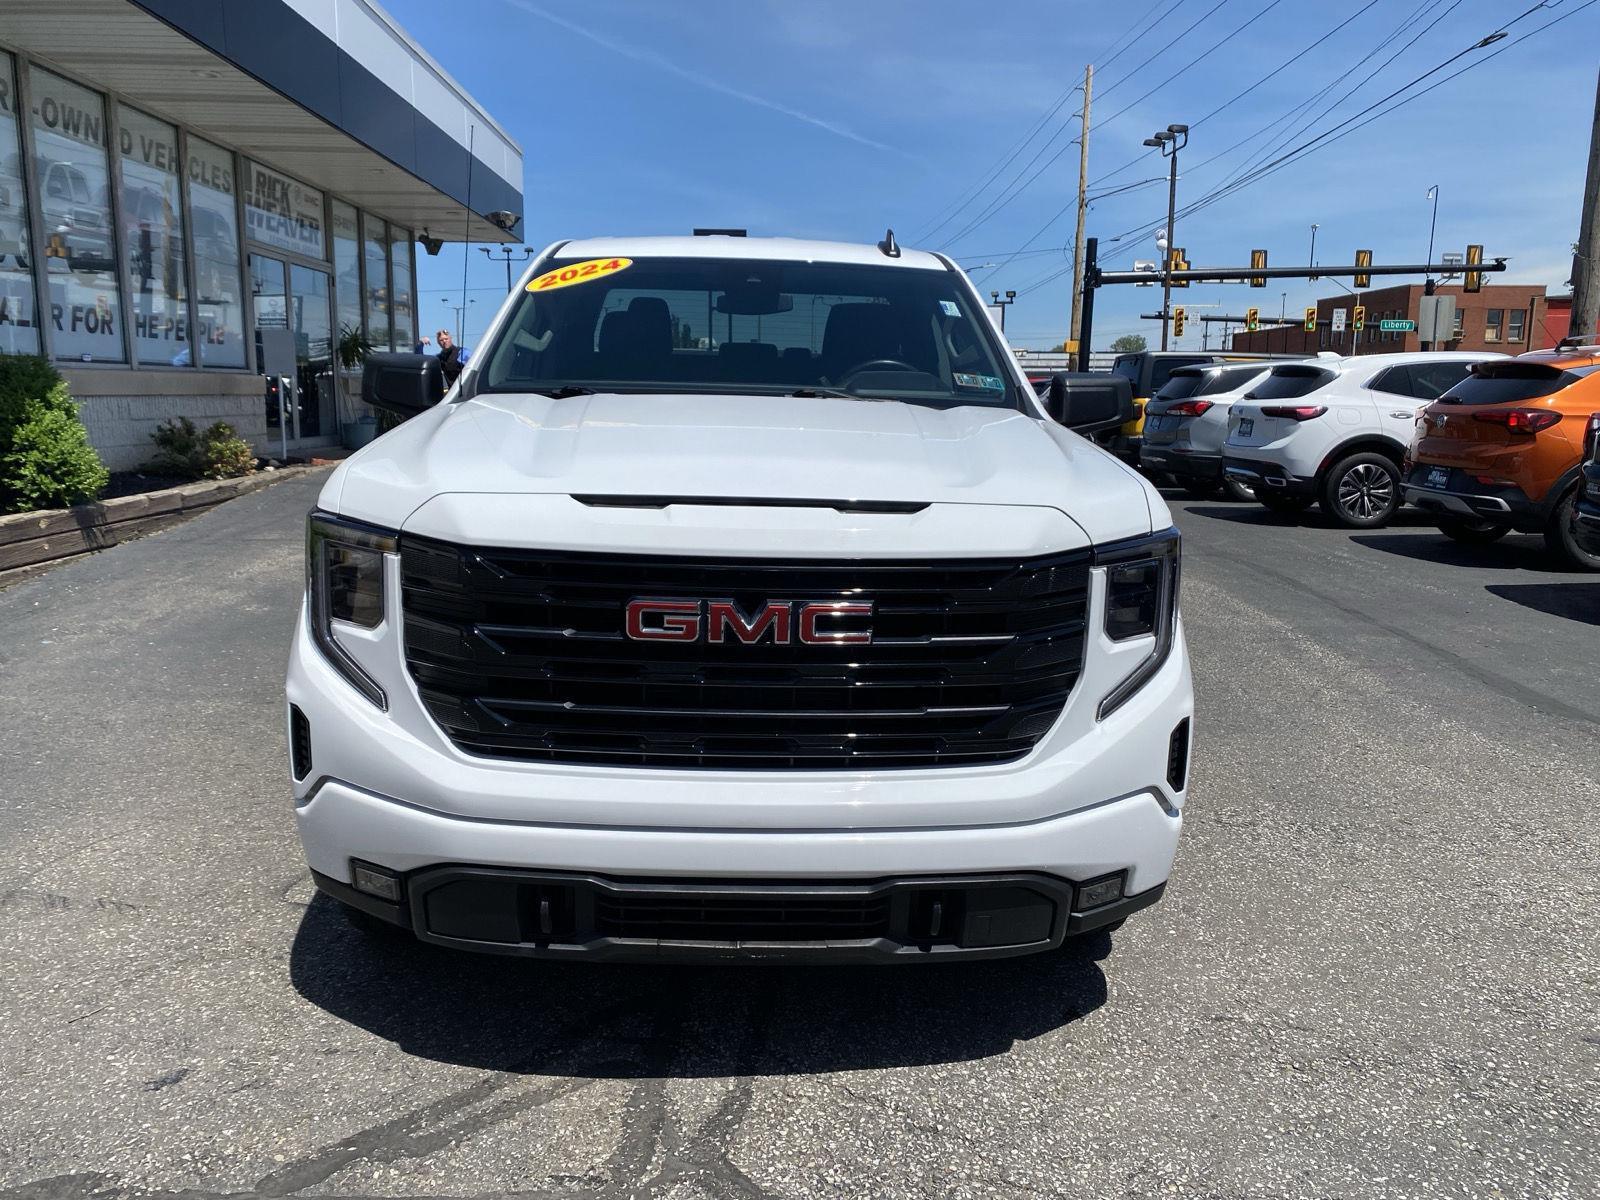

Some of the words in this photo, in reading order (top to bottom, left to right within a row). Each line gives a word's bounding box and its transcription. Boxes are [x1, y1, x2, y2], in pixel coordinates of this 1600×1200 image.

[140, 134, 232, 193] VEHCLES
[256, 170, 292, 206] RICK
[539, 260, 621, 289] 2024
[71, 305, 114, 335] FOR
[135, 314, 159, 339] HE
[1384, 321, 1411, 330] Liberty
[626, 598, 873, 644] GMC
